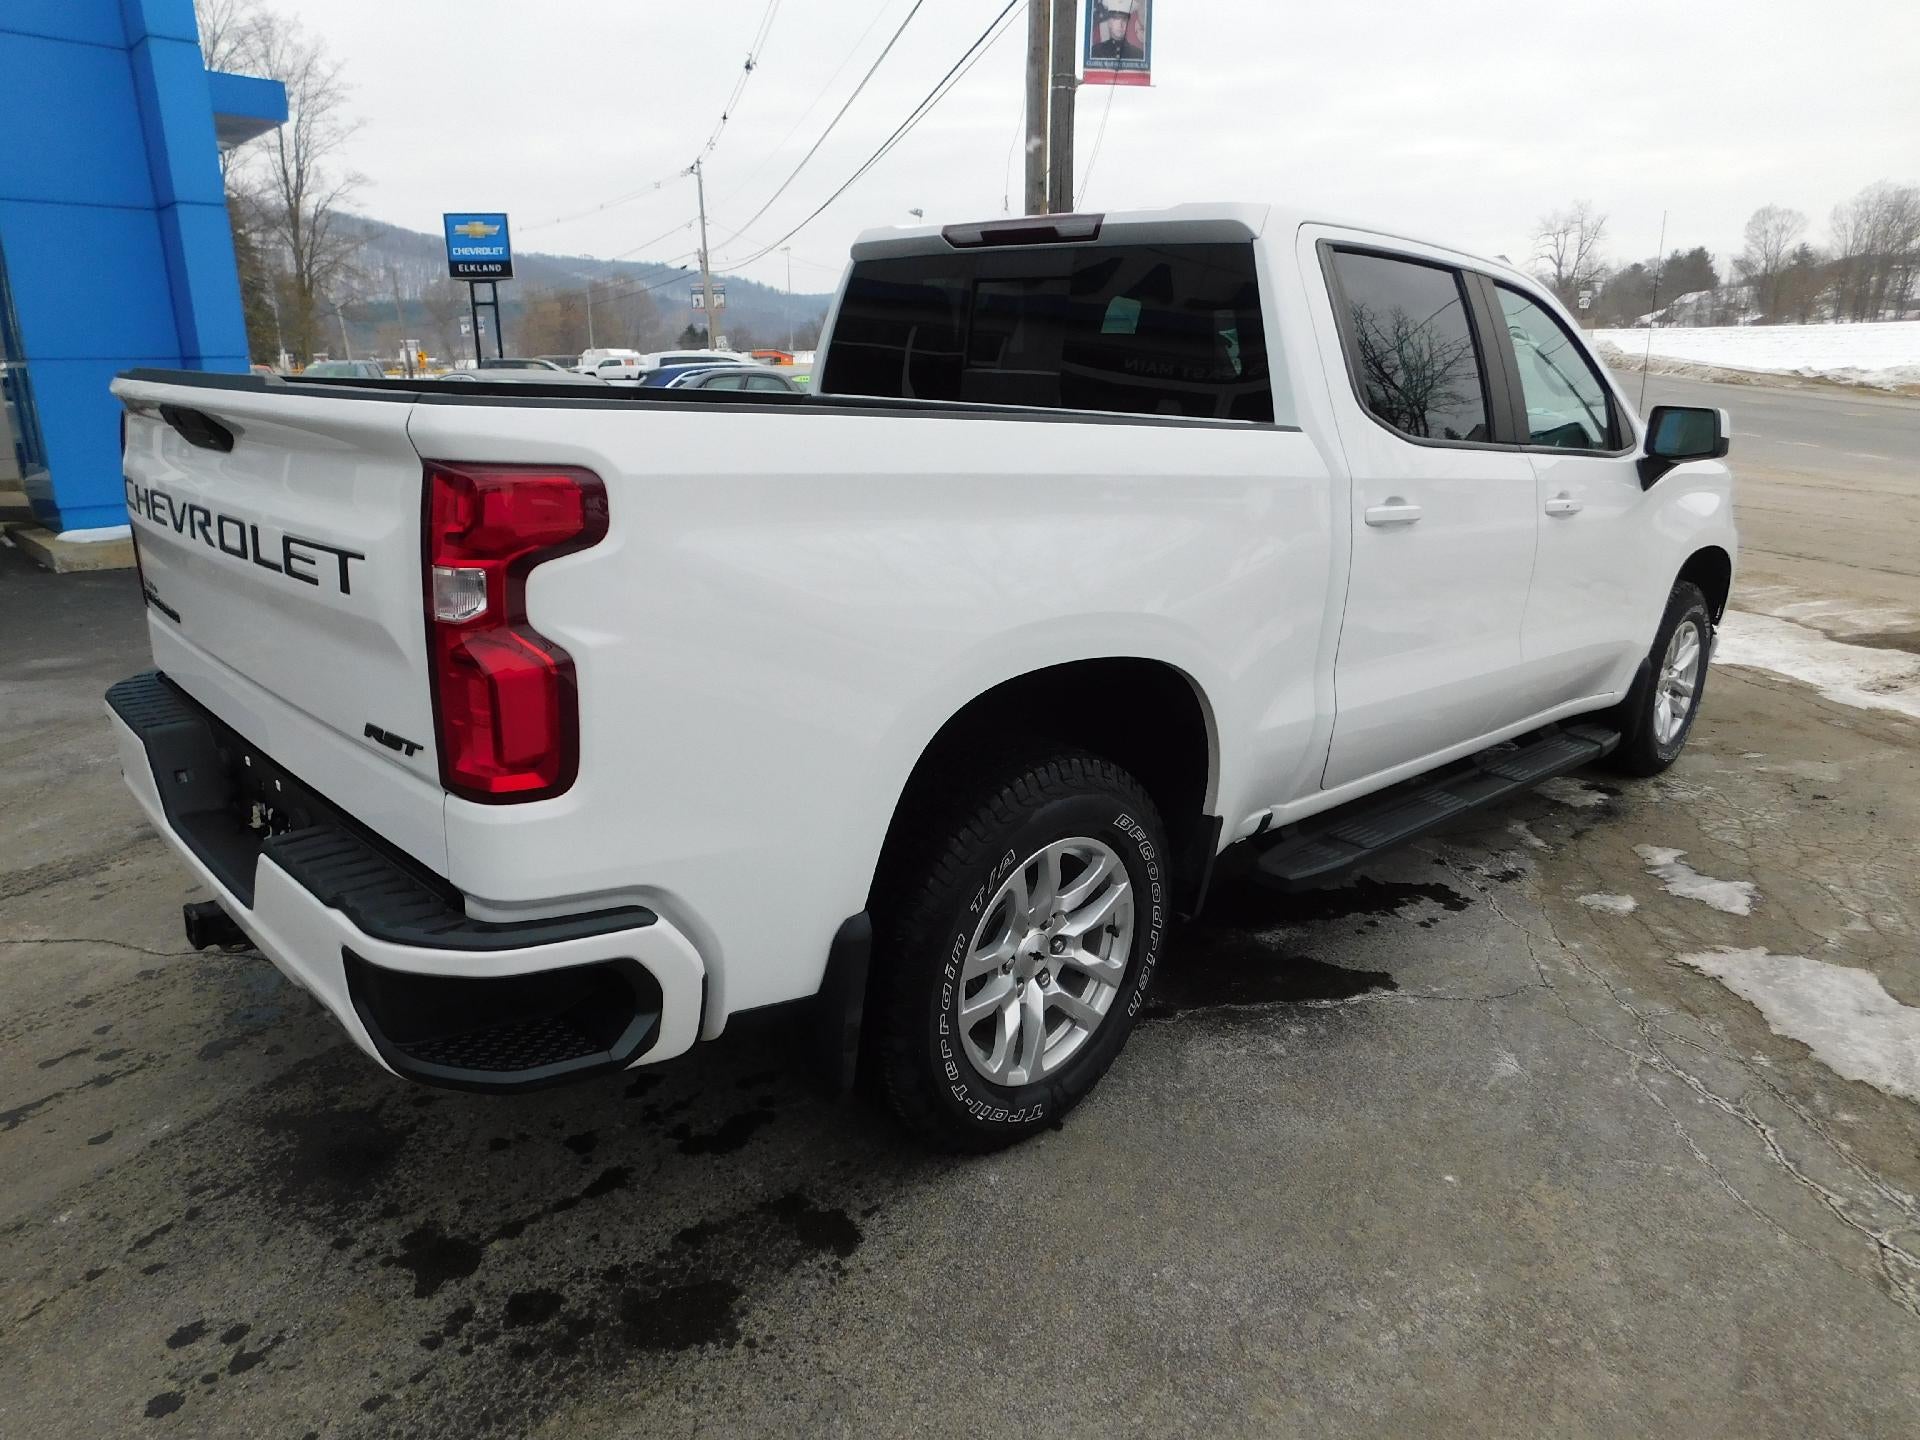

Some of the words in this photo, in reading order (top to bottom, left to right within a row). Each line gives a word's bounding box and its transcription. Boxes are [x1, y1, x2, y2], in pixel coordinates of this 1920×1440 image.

[453, 247, 504, 256] CHEVROLET
[458, 264, 502, 272] ELKLAND
[124, 477, 365, 595] CHEVROLET
[364, 722, 424, 756] RST
[970, 848, 1016, 914] T/A
[1113, 813, 1162, 1017] BFGoodrich
